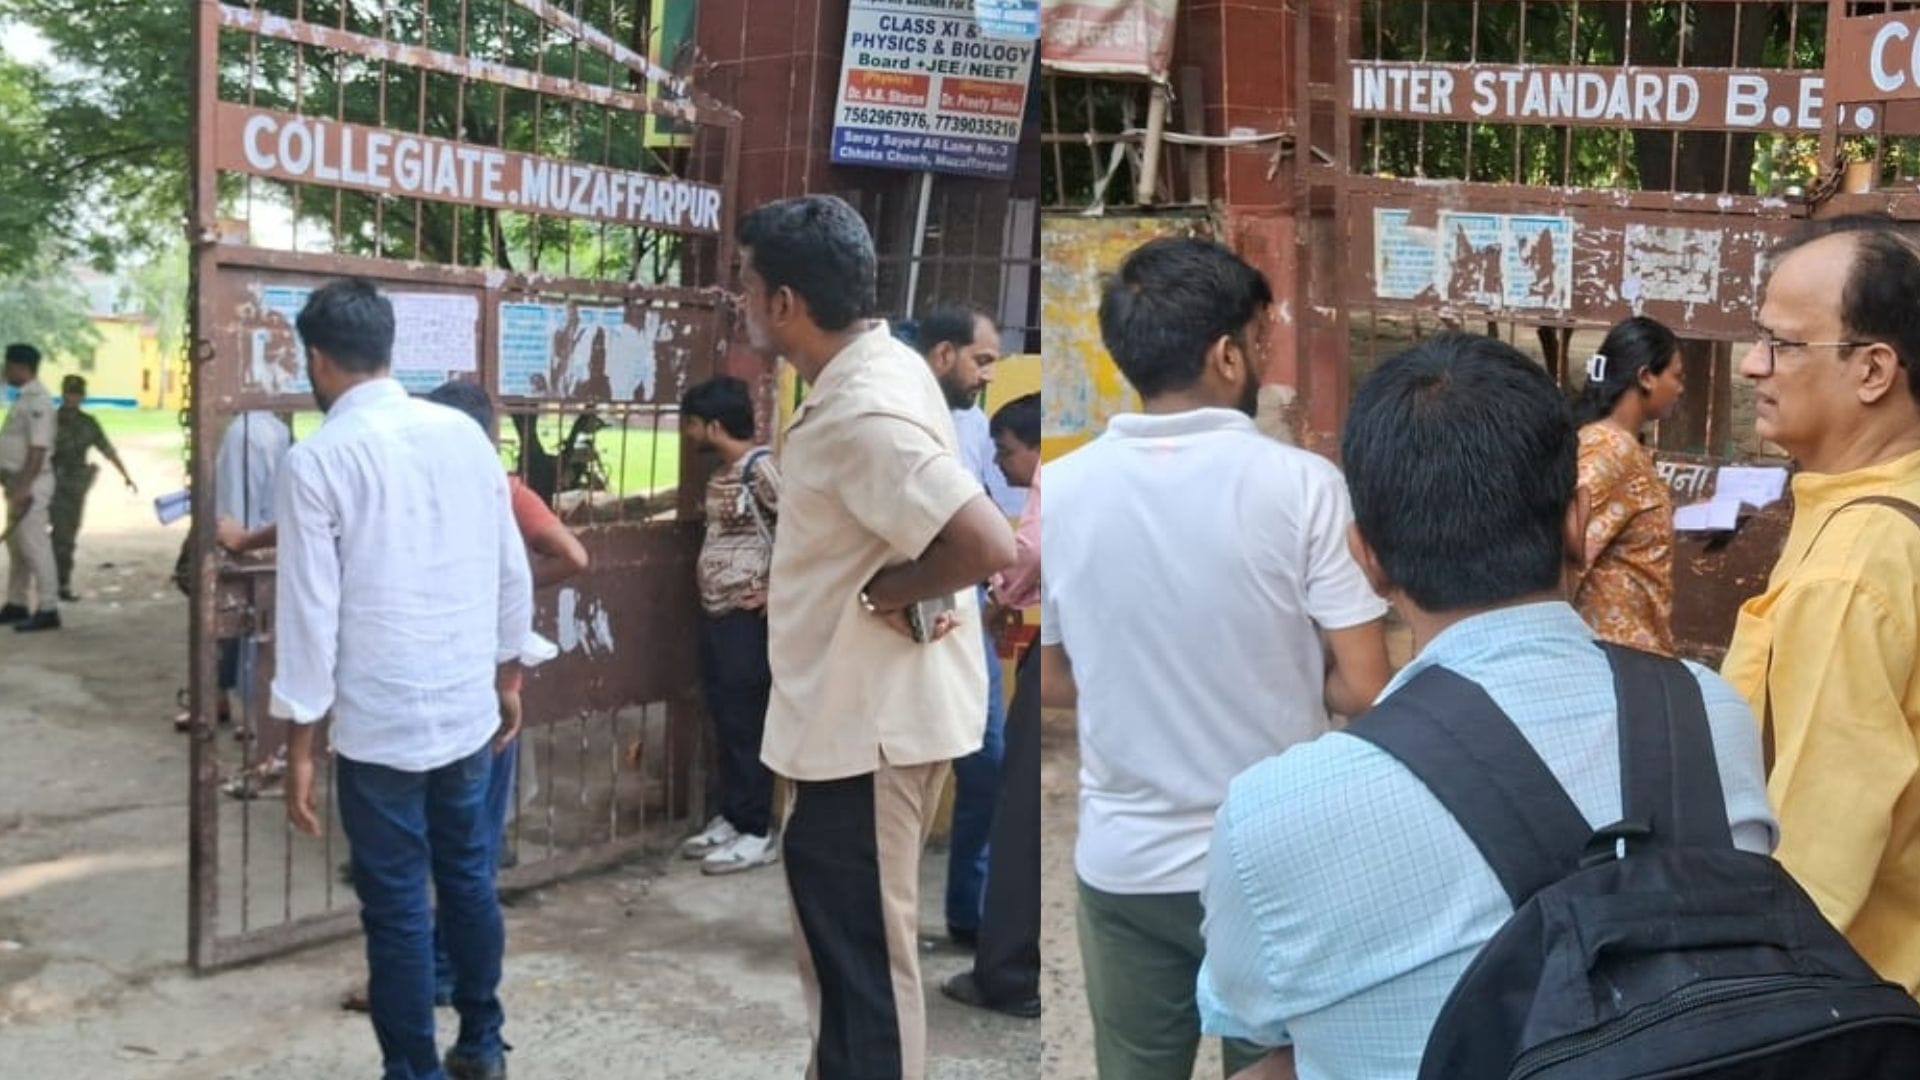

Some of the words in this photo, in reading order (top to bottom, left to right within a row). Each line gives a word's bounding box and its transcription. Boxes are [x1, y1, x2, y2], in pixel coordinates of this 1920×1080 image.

[879, 15, 935, 35] CLASS
[941, 20, 959, 37] XI
[965, 23, 977, 39] &
[851, 32, 926, 53] PHYSICS
[932, 39, 945, 55] &
[951, 41, 1031, 62] BIOLOGY
[858, 52, 910, 69] Board
[1870, 21, 1920, 92] C
[1353, 66, 1454, 115] INTER
[1471, 71, 1699, 122] STANDARD
[1725, 74, 1875, 129] B.E.
